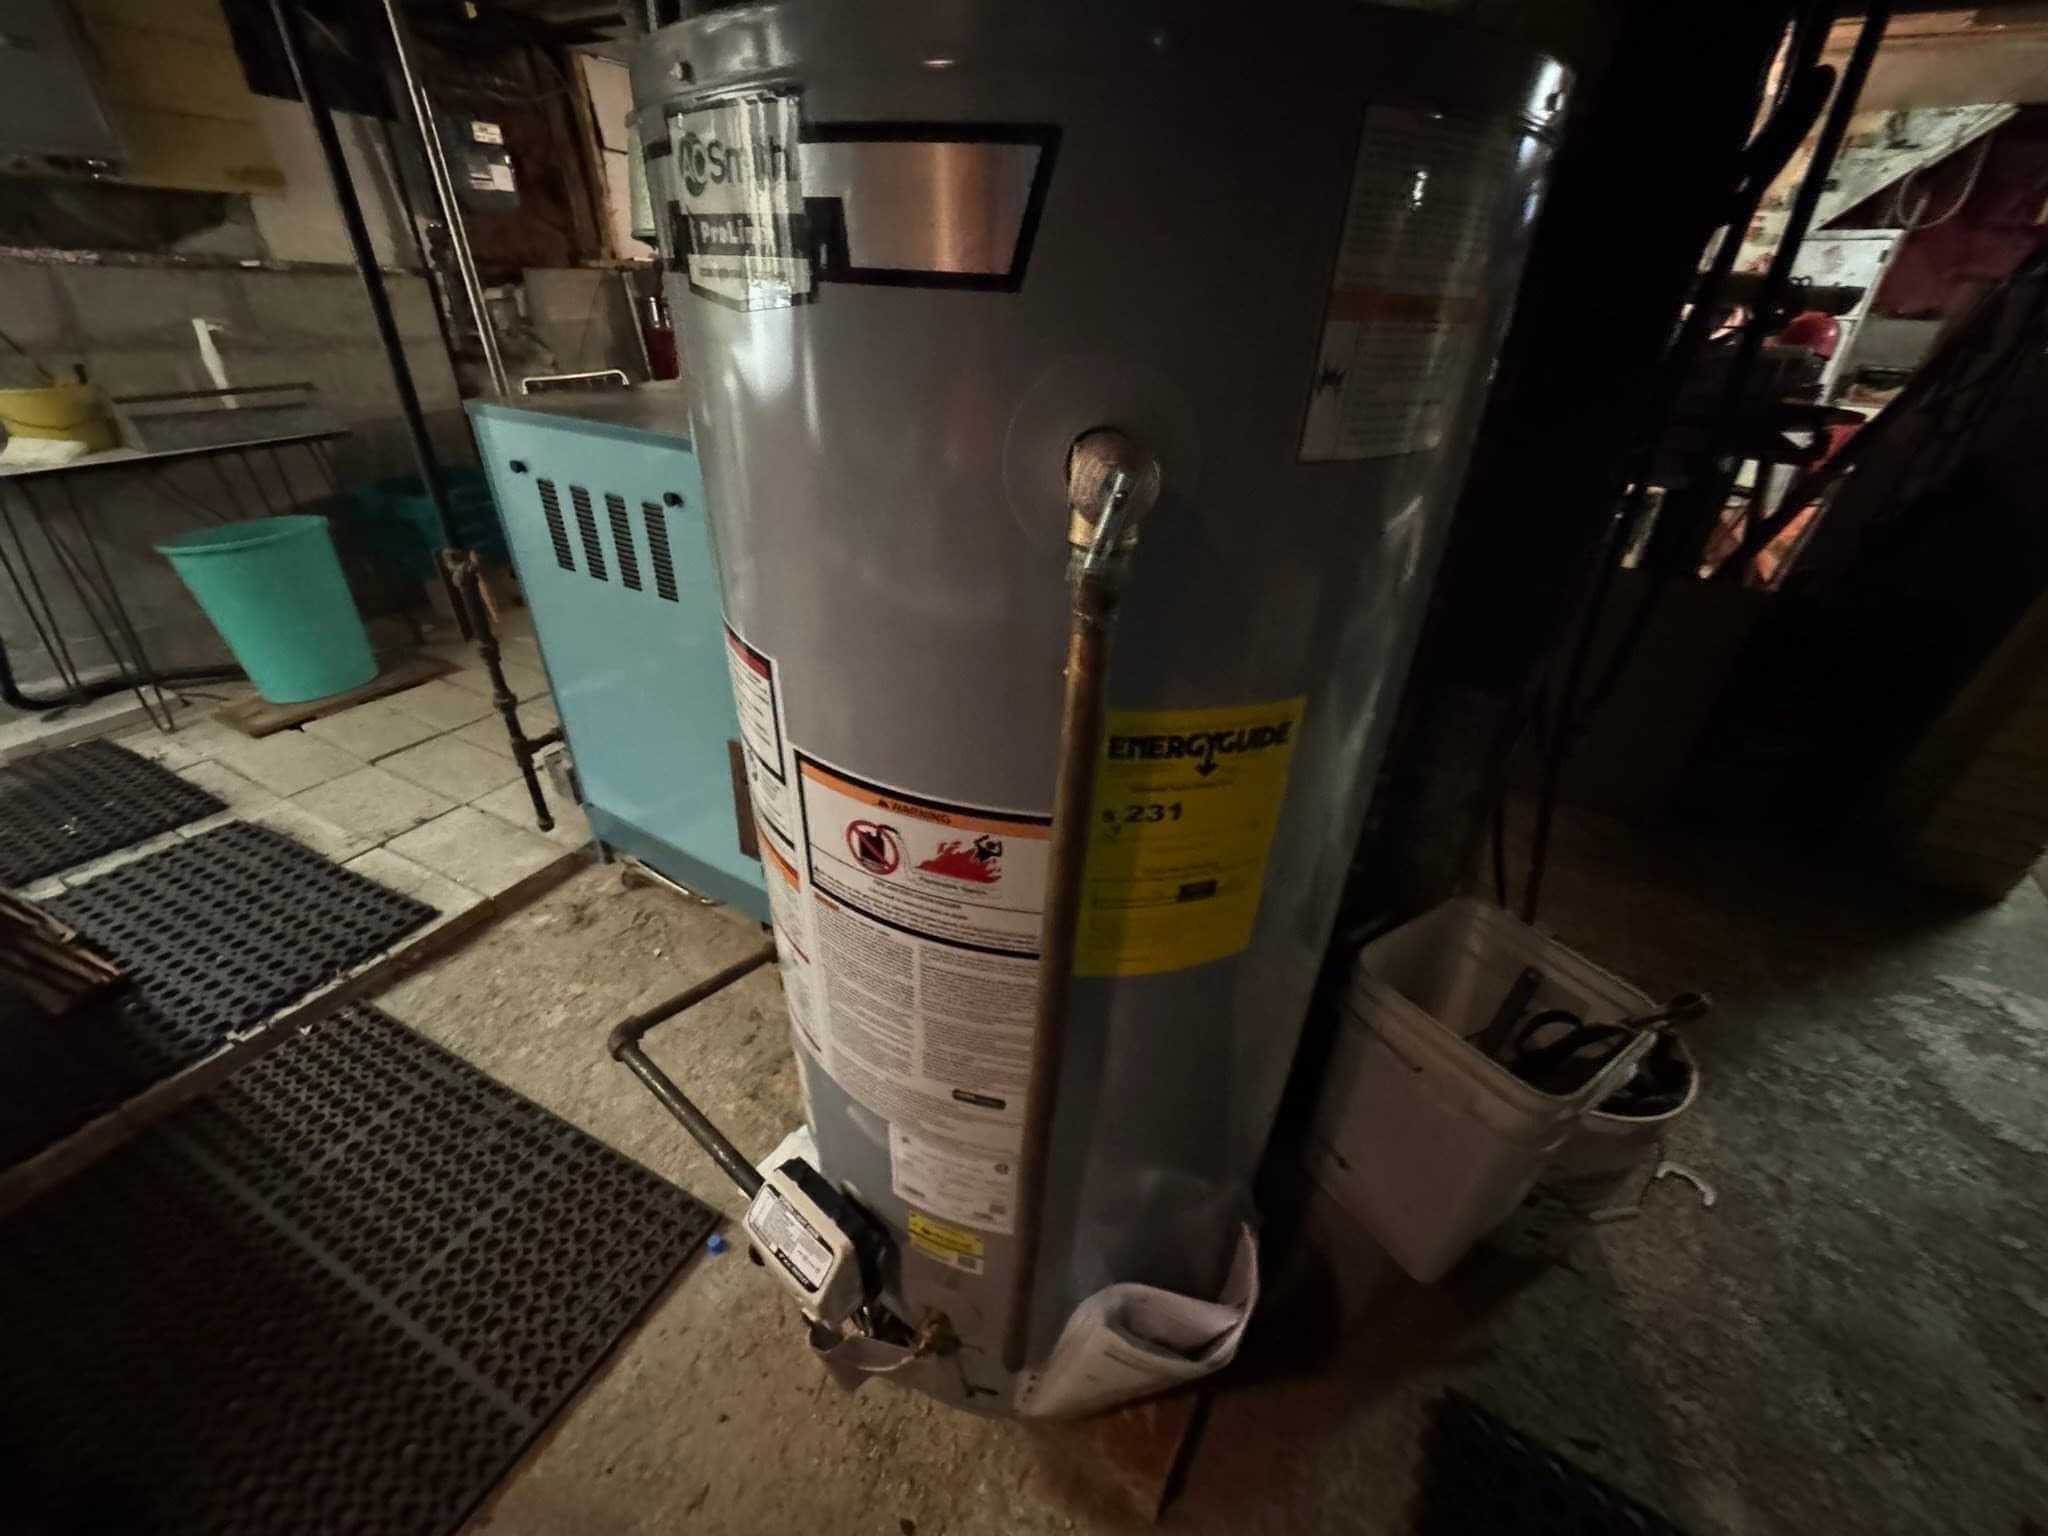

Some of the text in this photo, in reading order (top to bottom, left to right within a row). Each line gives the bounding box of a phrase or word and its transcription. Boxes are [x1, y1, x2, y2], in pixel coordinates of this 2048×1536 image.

[1109, 720, 1293, 766] ENERGYGUIDE
[891, 801, 951, 825] WARNING
[1125, 801, 1182, 824] 231
